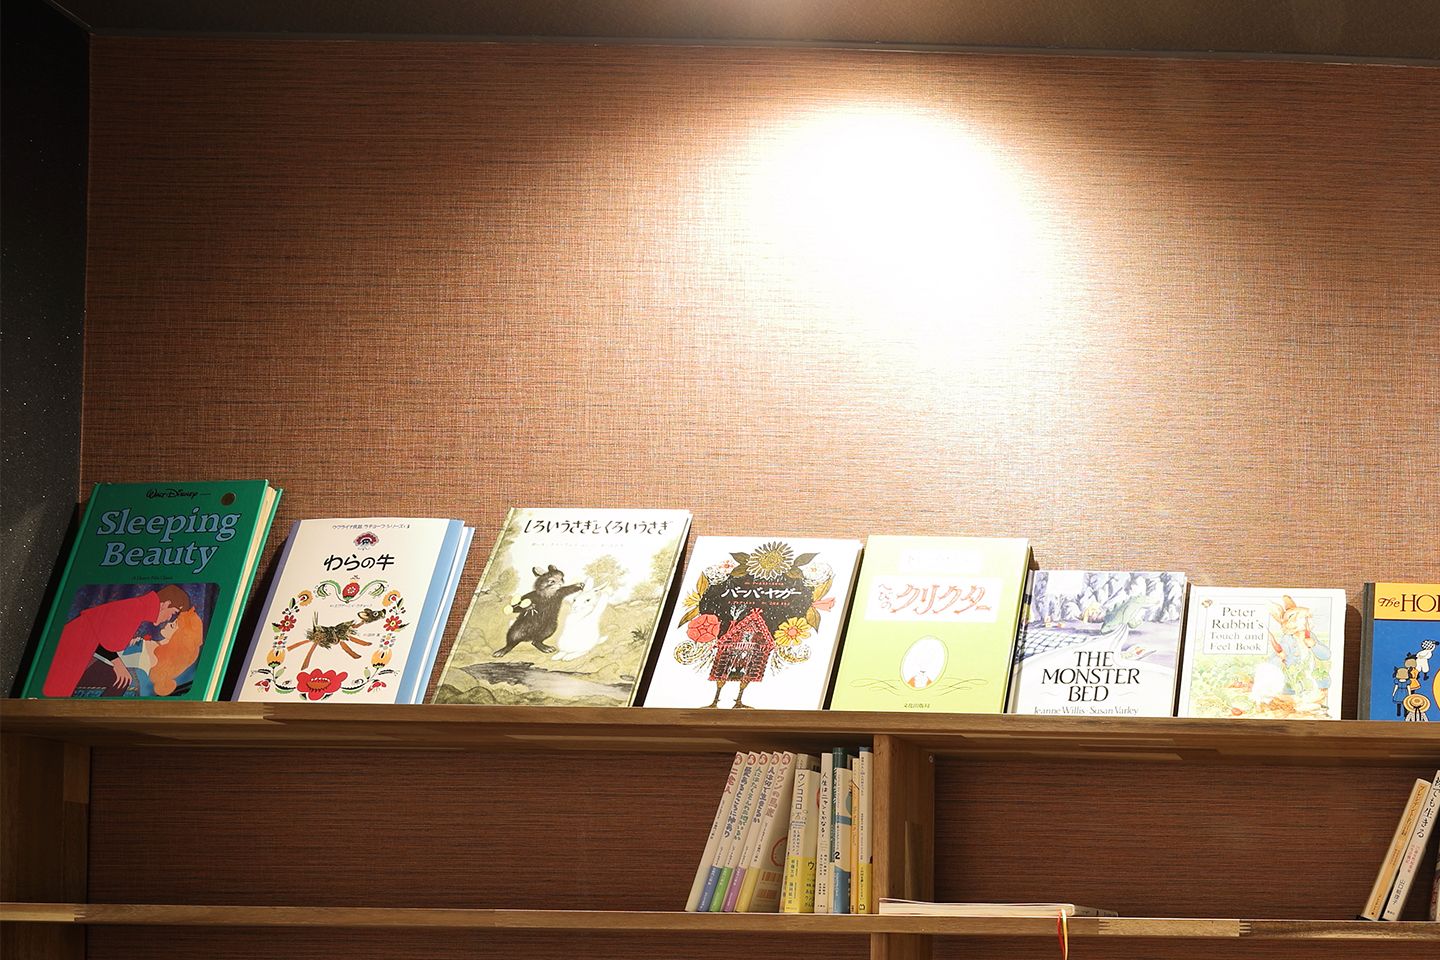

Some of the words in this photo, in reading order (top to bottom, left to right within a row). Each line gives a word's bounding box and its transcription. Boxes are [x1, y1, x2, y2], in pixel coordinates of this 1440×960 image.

[96, 506, 242, 542] Sleeping
[523, 519, 674, 535] しろいうさぎとくろいうさぎ
[100, 541, 219, 574] Beauty
[323, 553, 396, 571] わらの牛
[1377, 597, 1400, 608] The
[1222, 606, 1256, 617] Peter
[1212, 619, 1264, 630] Rabbit's
[1211, 631, 1240, 640] Touch
[1245, 632, 1264, 641] and
[1210, 642, 1231, 651] Feel
[1236, 642, 1261, 651] Book
[1073, 650, 1115, 668] THE
[1041, 668, 1141, 686] MONSTER
[1067, 685, 1109, 702] BED
[1034, 705, 1062, 715] Jeanne
[1089, 705, 1114, 715] Susan
